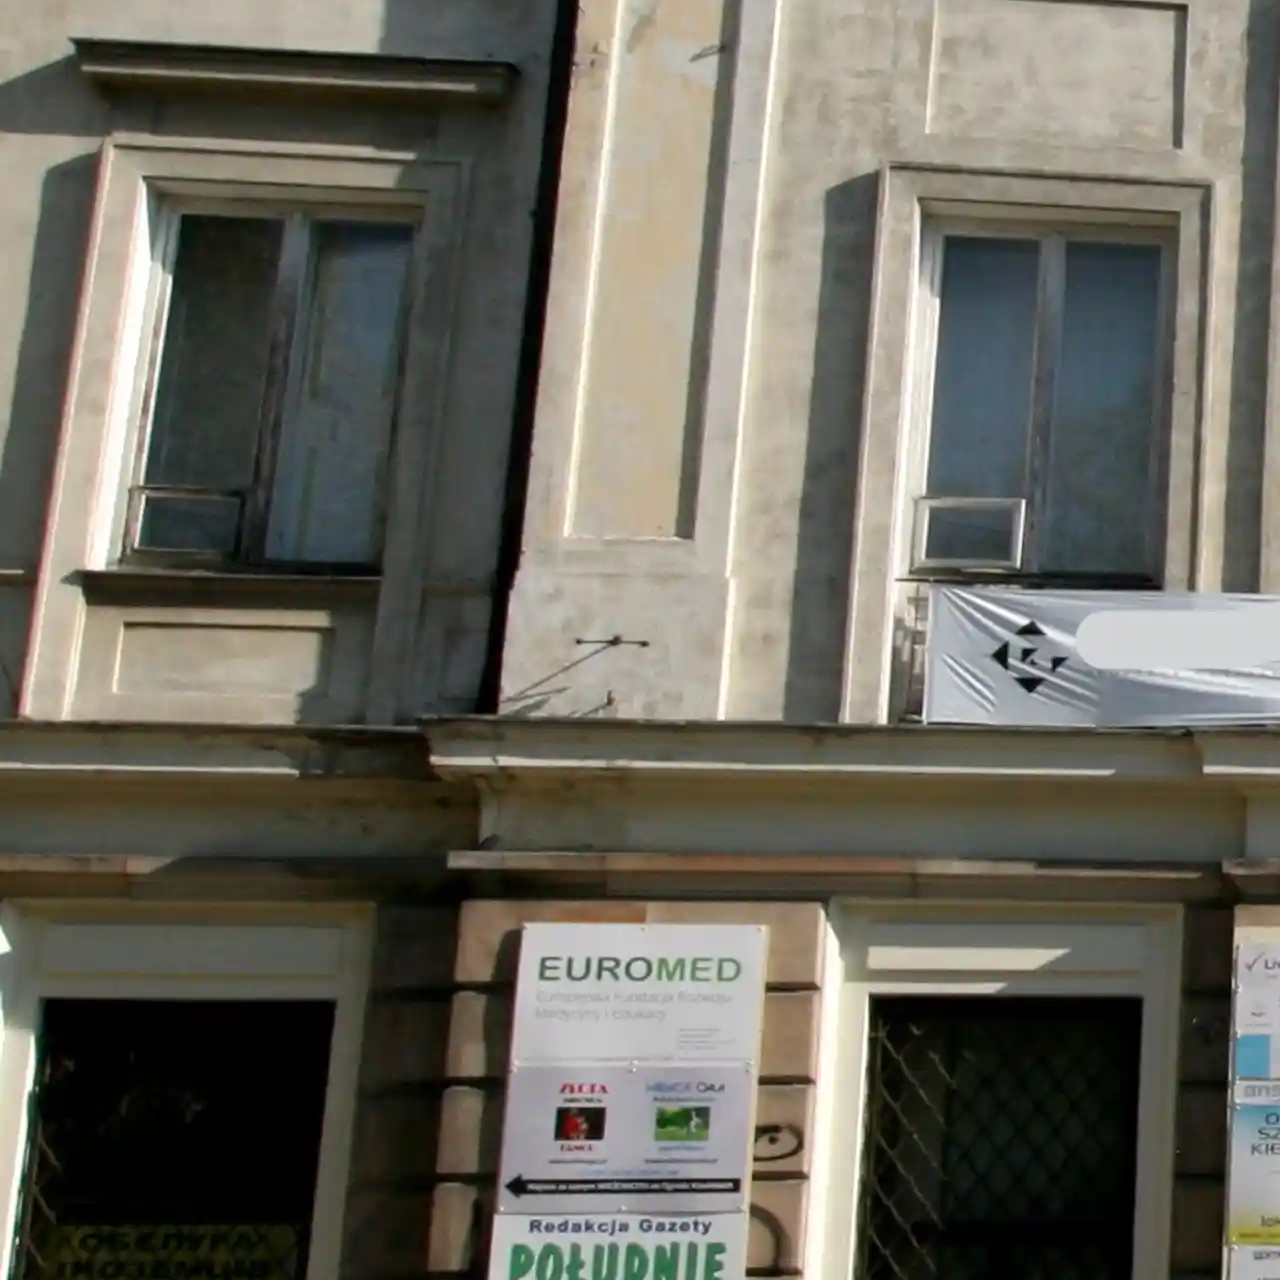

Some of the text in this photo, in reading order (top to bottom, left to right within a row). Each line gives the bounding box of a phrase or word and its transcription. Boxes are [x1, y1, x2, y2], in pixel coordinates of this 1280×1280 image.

[538, 956, 742, 982] EUROMED
[529, 1218, 713, 1236] Redakcja Gazety
